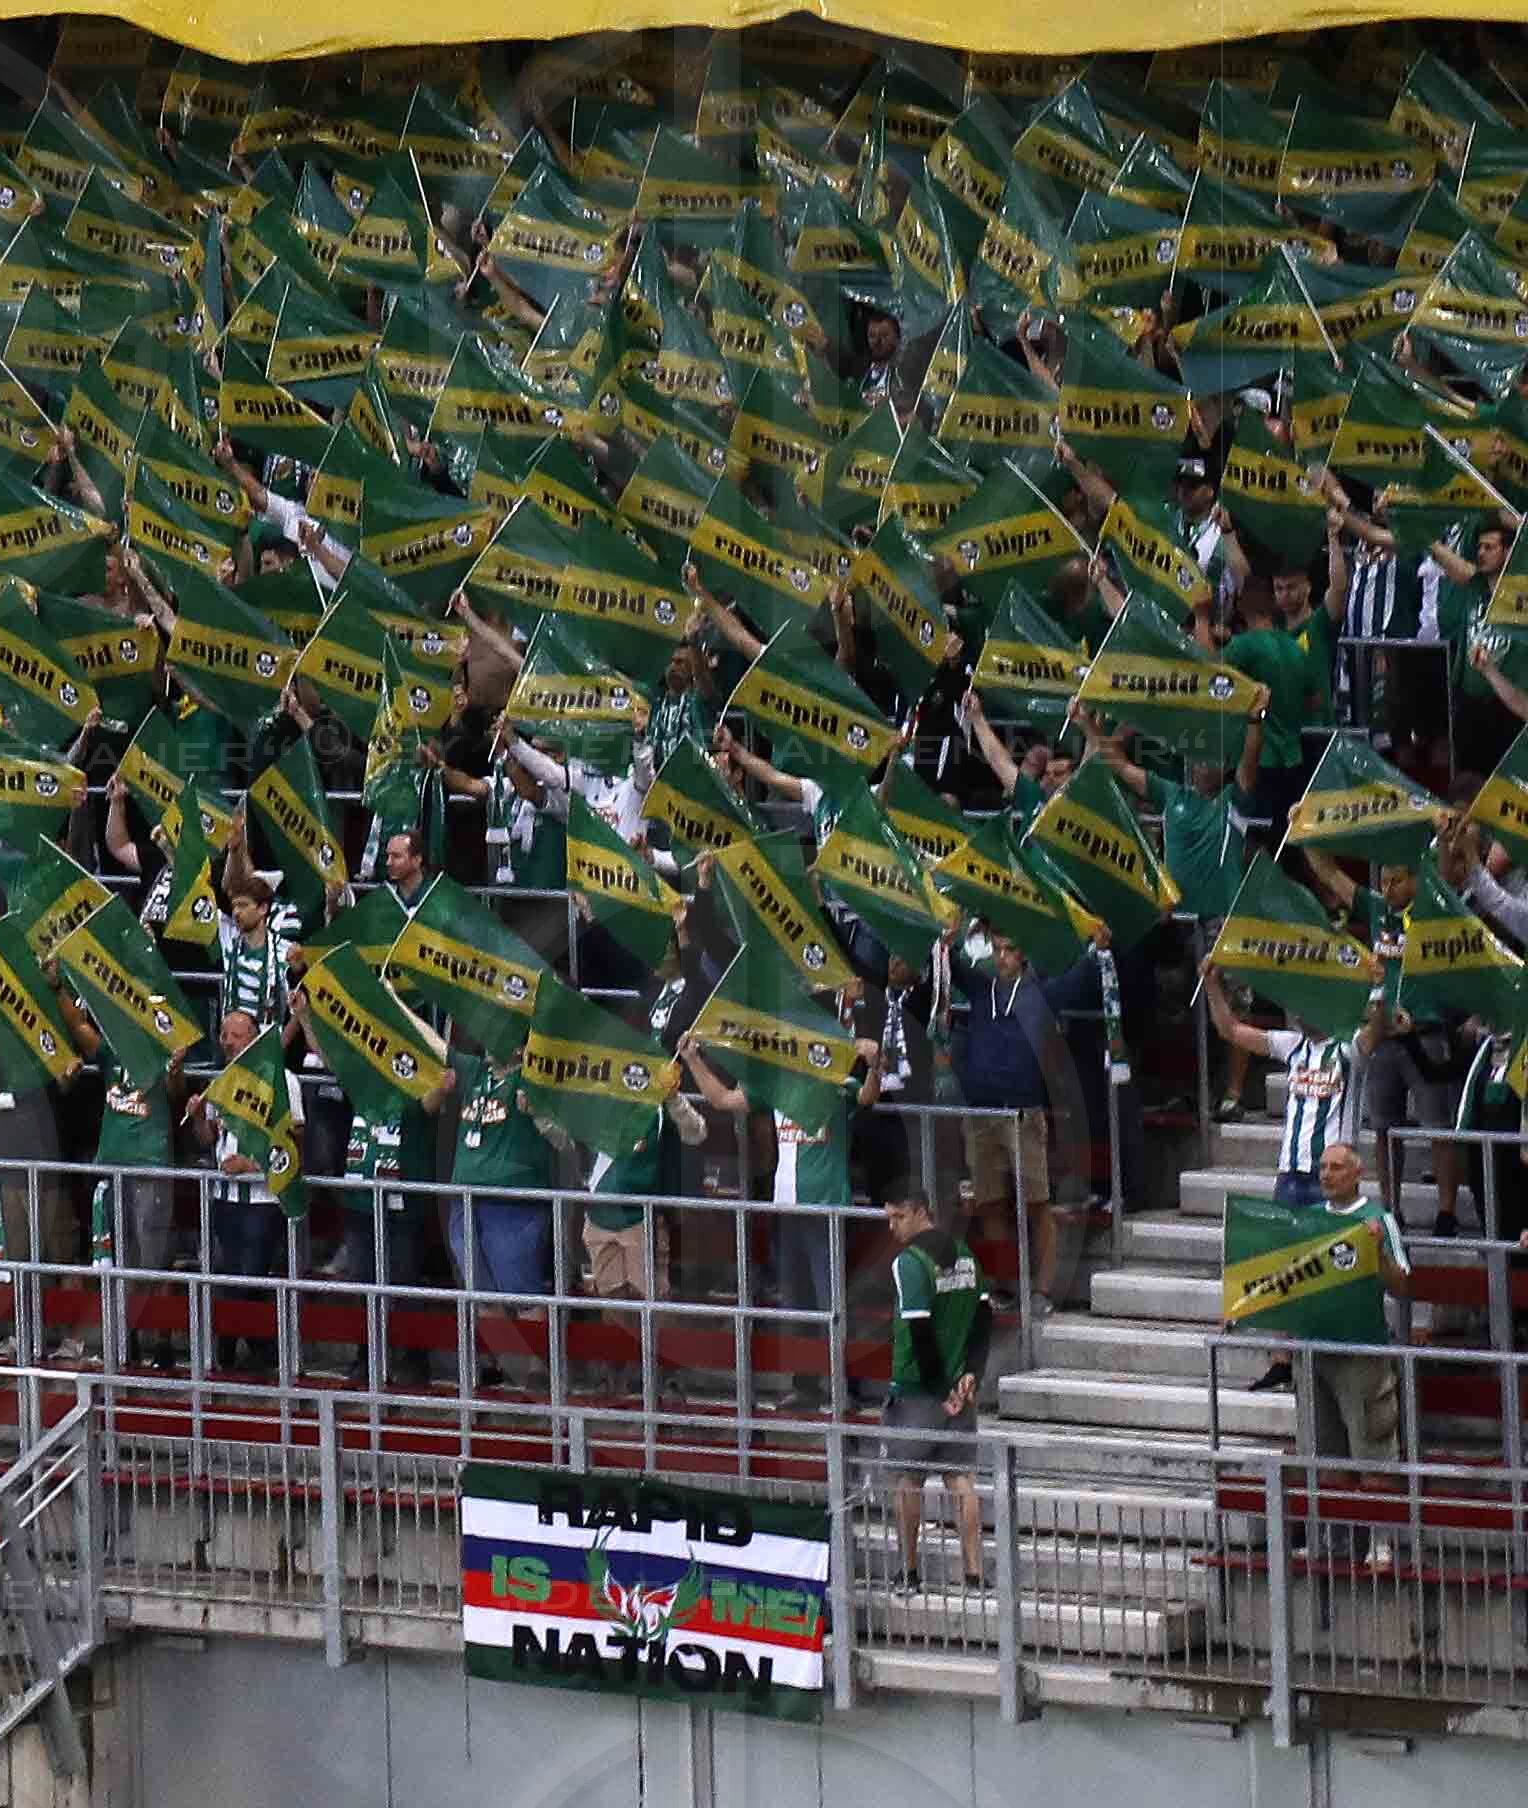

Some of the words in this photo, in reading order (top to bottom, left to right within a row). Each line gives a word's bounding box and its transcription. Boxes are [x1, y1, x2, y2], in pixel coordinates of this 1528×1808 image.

[289, 344, 366, 369] rapid
[1067, 401, 1140, 430] rapid
[0, 520, 60, 551] rapid
[178, 637, 249, 669] rapid
[1110, 669, 1200, 697] rapid
[758, 686, 839, 734] rapid
[1055, 819, 1136, 873] rapid
[739, 854, 804, 944] rapid
[419, 940, 496, 984] rapid
[1419, 931, 1485, 962] rapid
[315, 983, 389, 1059] rapid
[526, 1050, 612, 1084] rapid
[537, 1480, 753, 1546] RAPID
[491, 1554, 551, 1601] IS
[511, 1624, 773, 1696] NATION
